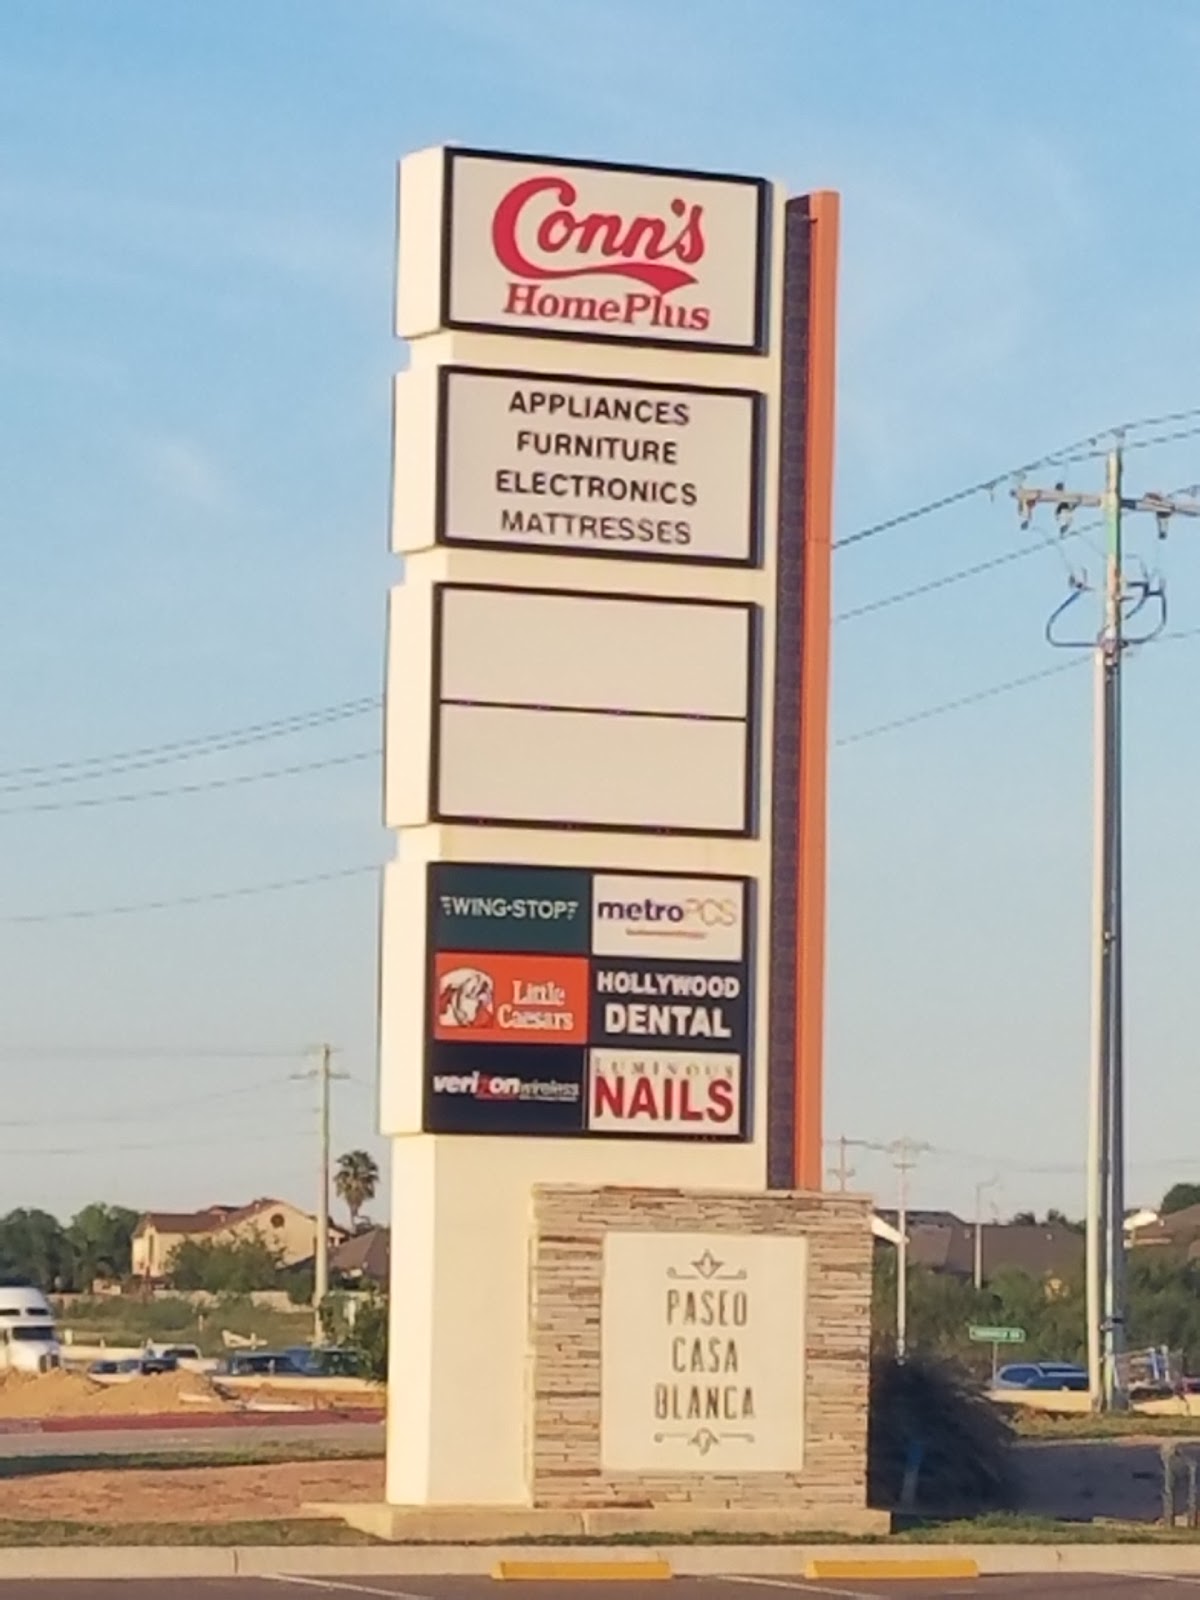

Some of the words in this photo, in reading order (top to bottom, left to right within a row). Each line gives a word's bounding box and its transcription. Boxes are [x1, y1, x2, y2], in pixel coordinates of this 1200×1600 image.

[492, 177, 704, 290] Conn's
[503, 282, 710, 330] HomePlus
[509, 390, 690, 426] APPLIANCES
[517, 430, 678, 465] FURNITURE
[496, 469, 697, 506] ELECTRONICS
[501, 509, 691, 545] MATTRESSES
[598, 898, 736, 926] metroPCS
[512, 980, 565, 1006] Little
[597, 971, 740, 998] HOLLYWOOD
[498, 1004, 573, 1030] Caesars
[605, 1003, 731, 1038] DENTAL
[594, 1075, 733, 1123] NAILS
[667, 1289, 747, 1326] PASEO
[672, 1337, 738, 1372] CASA
[655, 1383, 755, 1420] BLANCA
